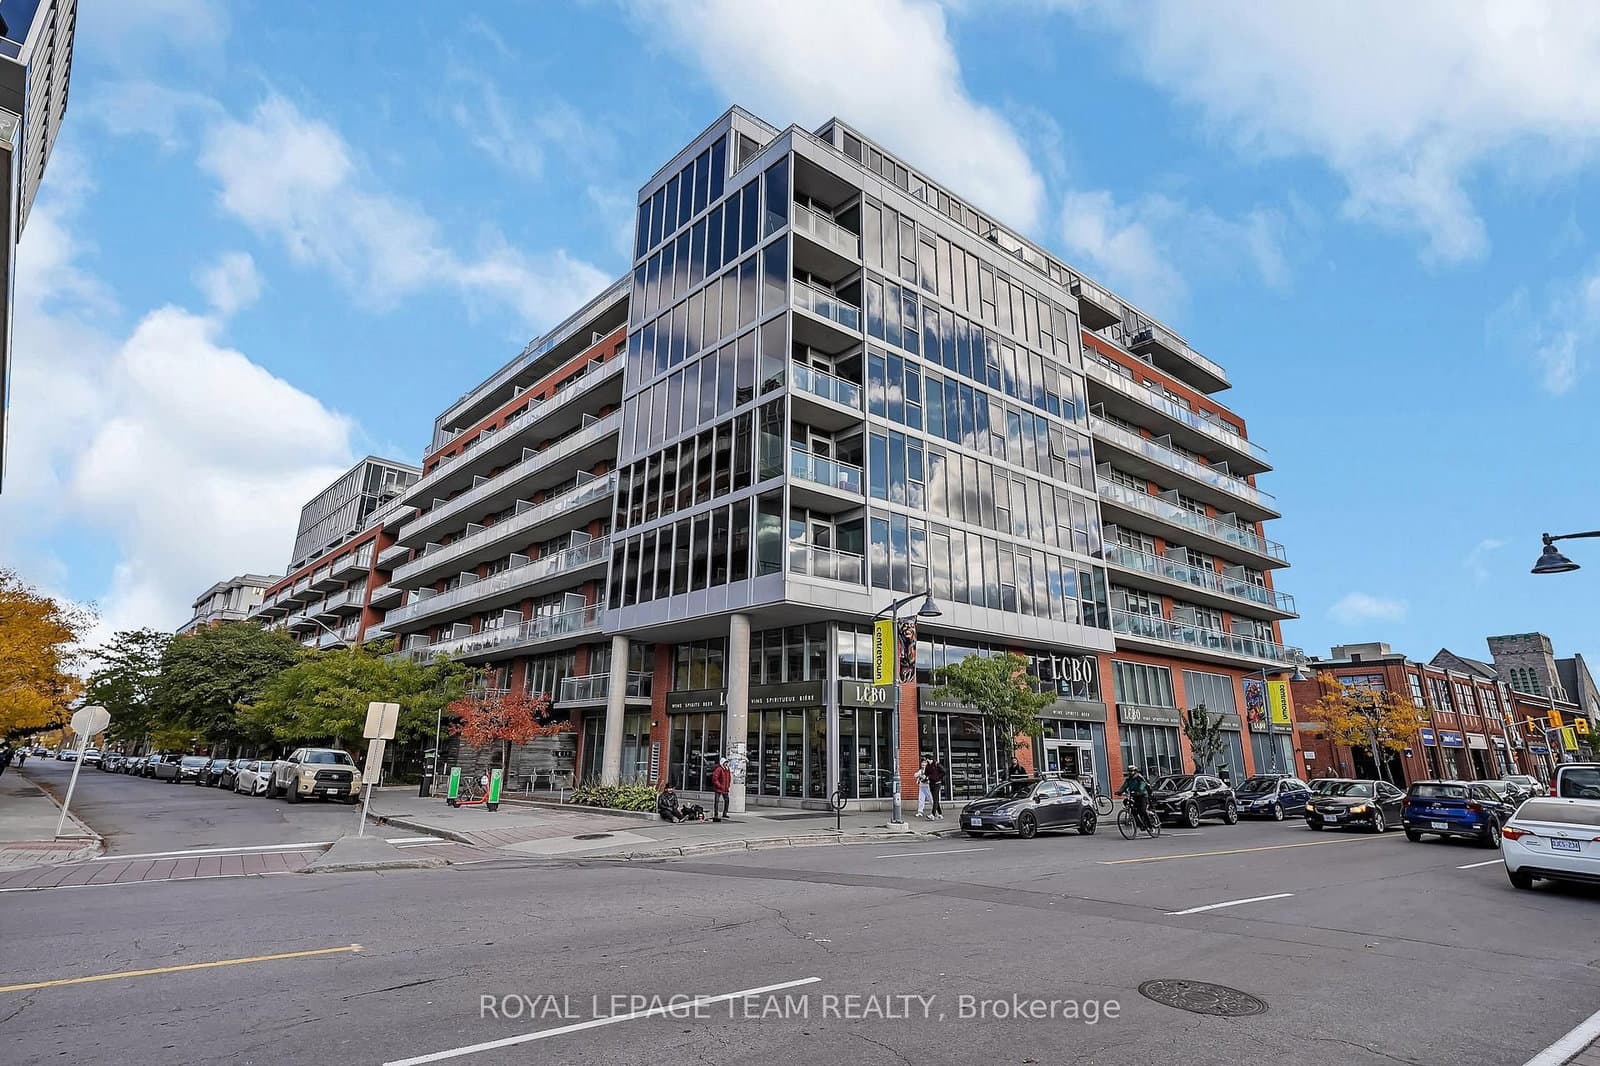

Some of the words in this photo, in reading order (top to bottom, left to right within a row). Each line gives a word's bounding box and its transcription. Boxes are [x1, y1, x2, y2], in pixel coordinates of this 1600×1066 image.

[1051, 655, 1092, 684] LCBO
[855, 686, 886, 703] LCBO
[1123, 707, 1141, 720] LCBO
